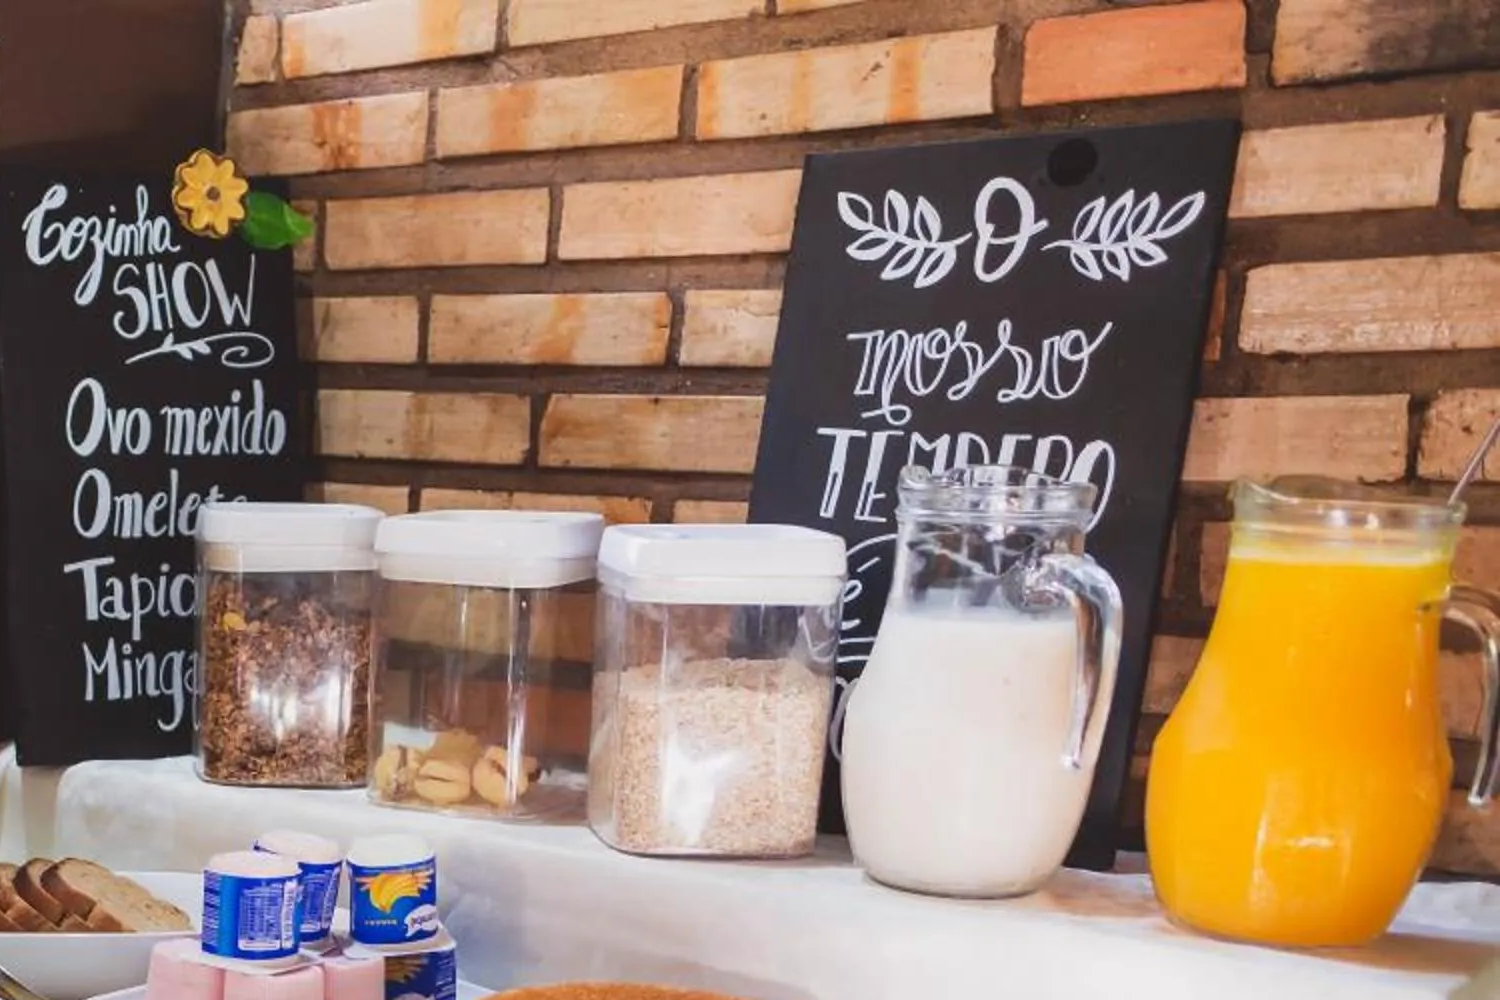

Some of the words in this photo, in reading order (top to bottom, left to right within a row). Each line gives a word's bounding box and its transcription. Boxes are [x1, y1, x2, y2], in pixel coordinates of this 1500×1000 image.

[21, 184, 181, 306] Cozinha
[973, 176, 1050, 283] O
[112, 253, 256, 339] SHOW
[846, 318, 1114, 425] nosso
[65, 377, 152, 457] Ovo
[160, 378, 287, 456] mexido
[73, 467, 250, 539] Omele
[63, 556, 199, 641] Tapio
[82, 637, 200, 732] Minga
